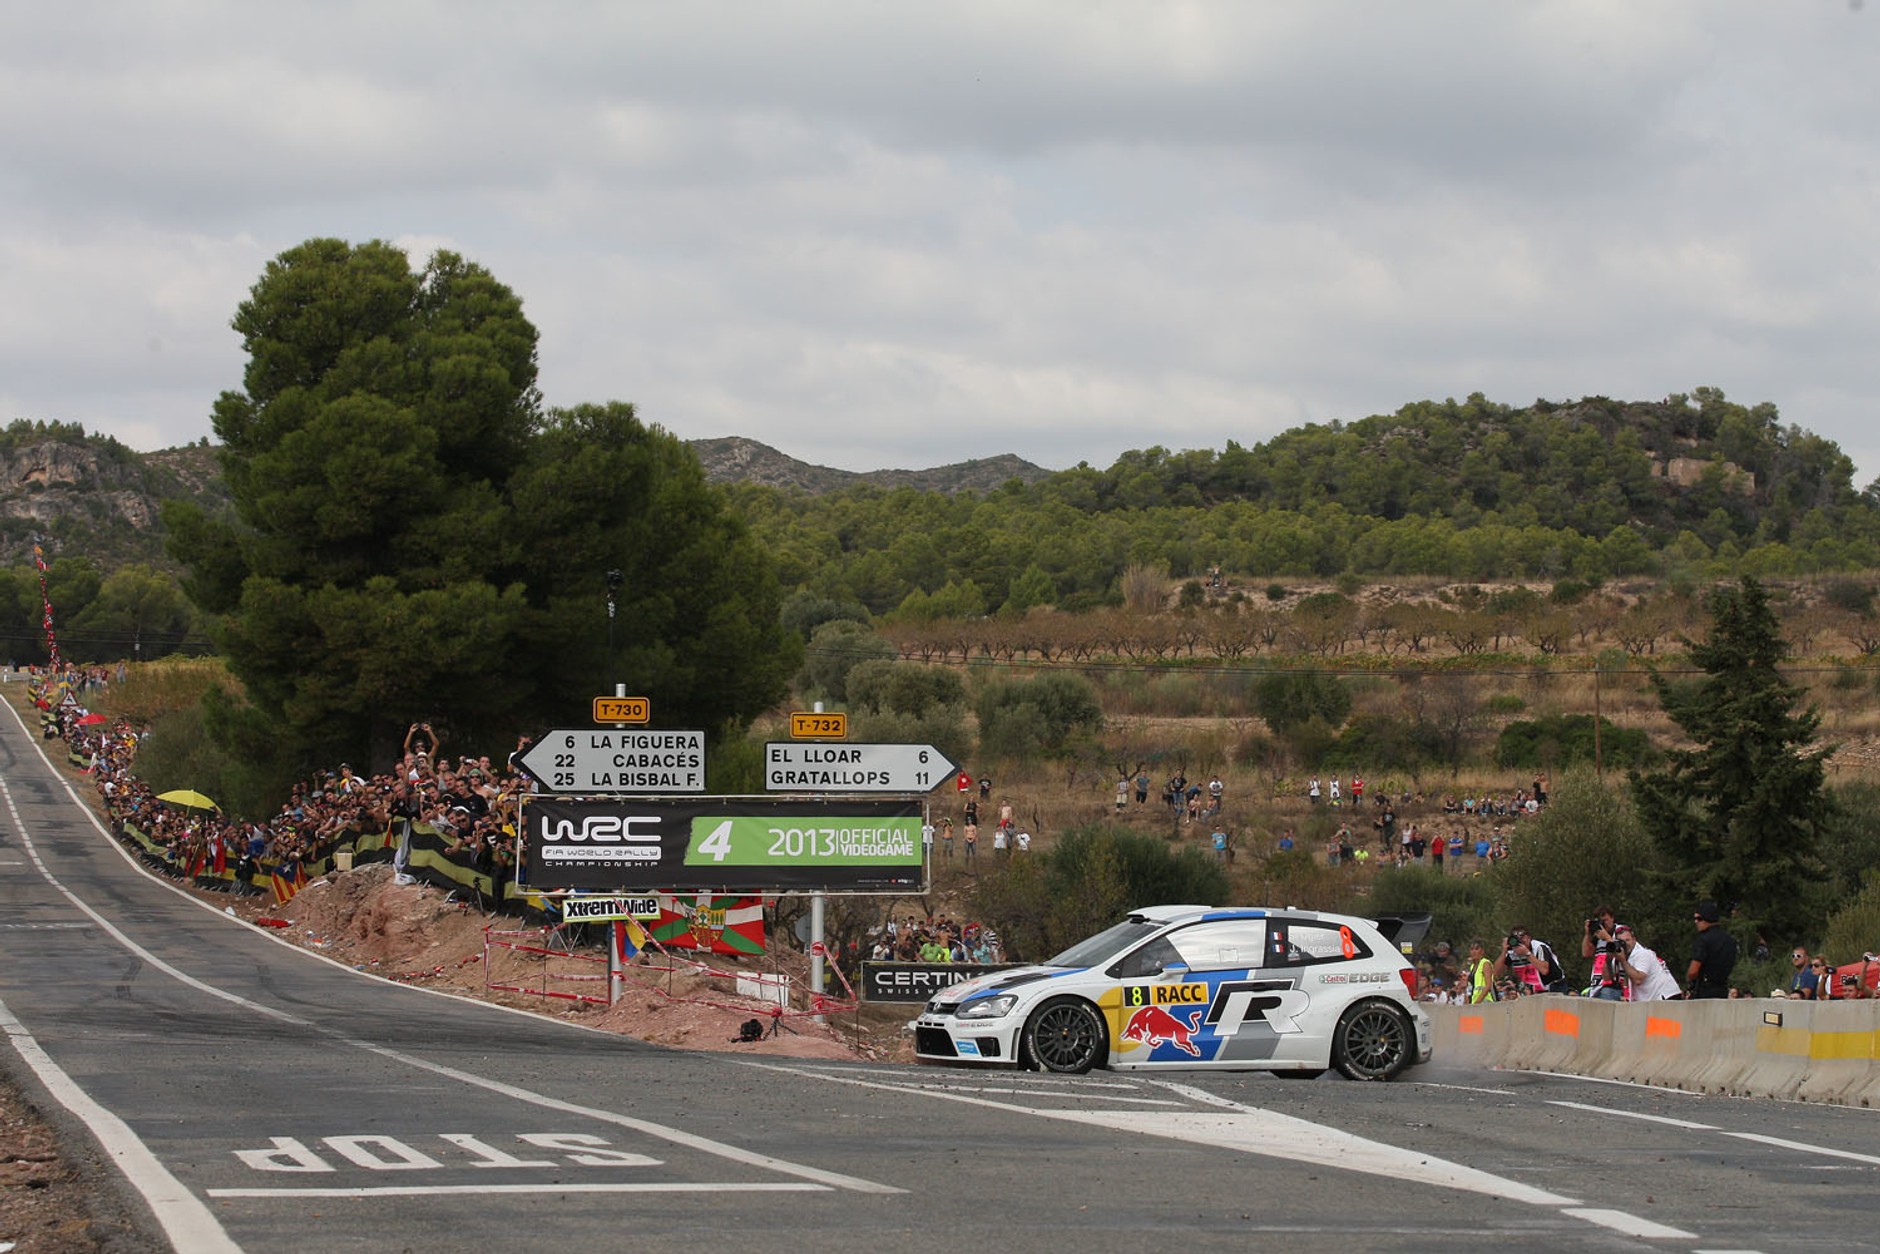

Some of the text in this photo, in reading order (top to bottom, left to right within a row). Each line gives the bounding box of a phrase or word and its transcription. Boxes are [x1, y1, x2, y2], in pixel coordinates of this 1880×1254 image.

[601, 704, 642, 716] T-730
[797, 720, 841, 731] T-732
[565, 736, 699, 749] 6 LA FIGUERA
[554, 752, 700, 768] 22 CABACÉS
[771, 750, 929, 764] EL LLOAR 6
[554, 773, 700, 786] 25 LA BISBAL F.
[771, 771, 929, 785] GRATALLOPS 11
[541, 815, 662, 842] WRC
[697, 821, 733, 861] 4
[768, 828, 835, 857] 2013
[839, 828, 914, 844] OFFICIAL
[545, 848, 658, 856] FIA WORLD RALLY
[840, 843, 914, 857] VIDEOGAME
[1340, 925, 1355, 959] 8
[875, 971, 984, 986] CERTIN
[1349, 972, 1391, 984] EDGE
[1131, 984, 1202, 1006] 8 RACC
[231, 1133, 666, 1172] STOP
